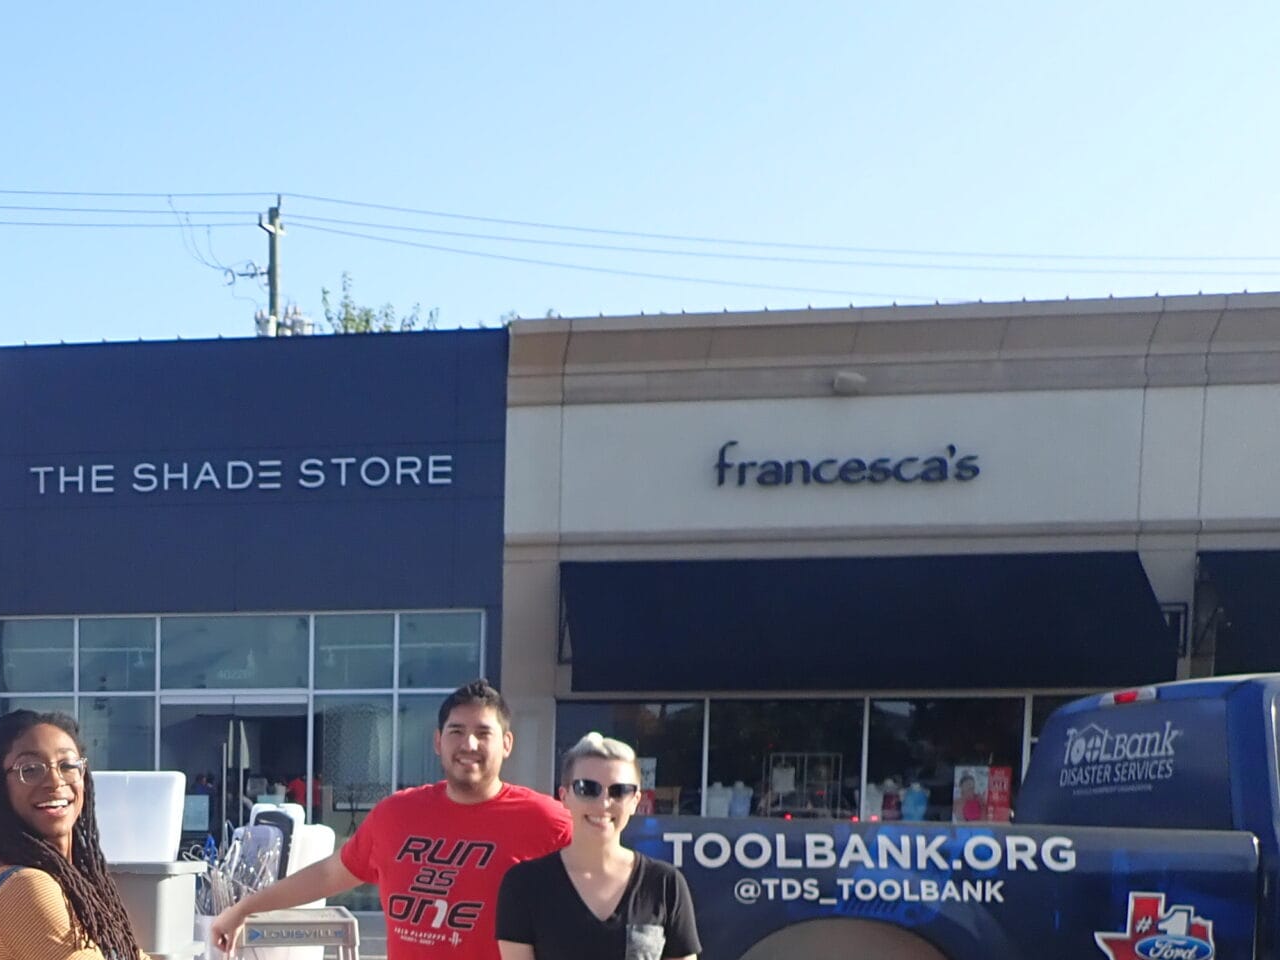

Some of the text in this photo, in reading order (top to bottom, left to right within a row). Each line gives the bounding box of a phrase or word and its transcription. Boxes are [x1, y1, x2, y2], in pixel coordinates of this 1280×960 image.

[30, 455, 452, 494] THE SHADE STORE
[714, 440, 980, 487] francesca's
[1059, 759, 1174, 788] DISASTER SERVICES
[663, 832, 1076, 872] TOOLBANK.ORG
[414, 867, 458, 887] as
[734, 878, 1005, 905] @TDS_TOOLBANK
[1148, 938, 1198, 960] Ford
